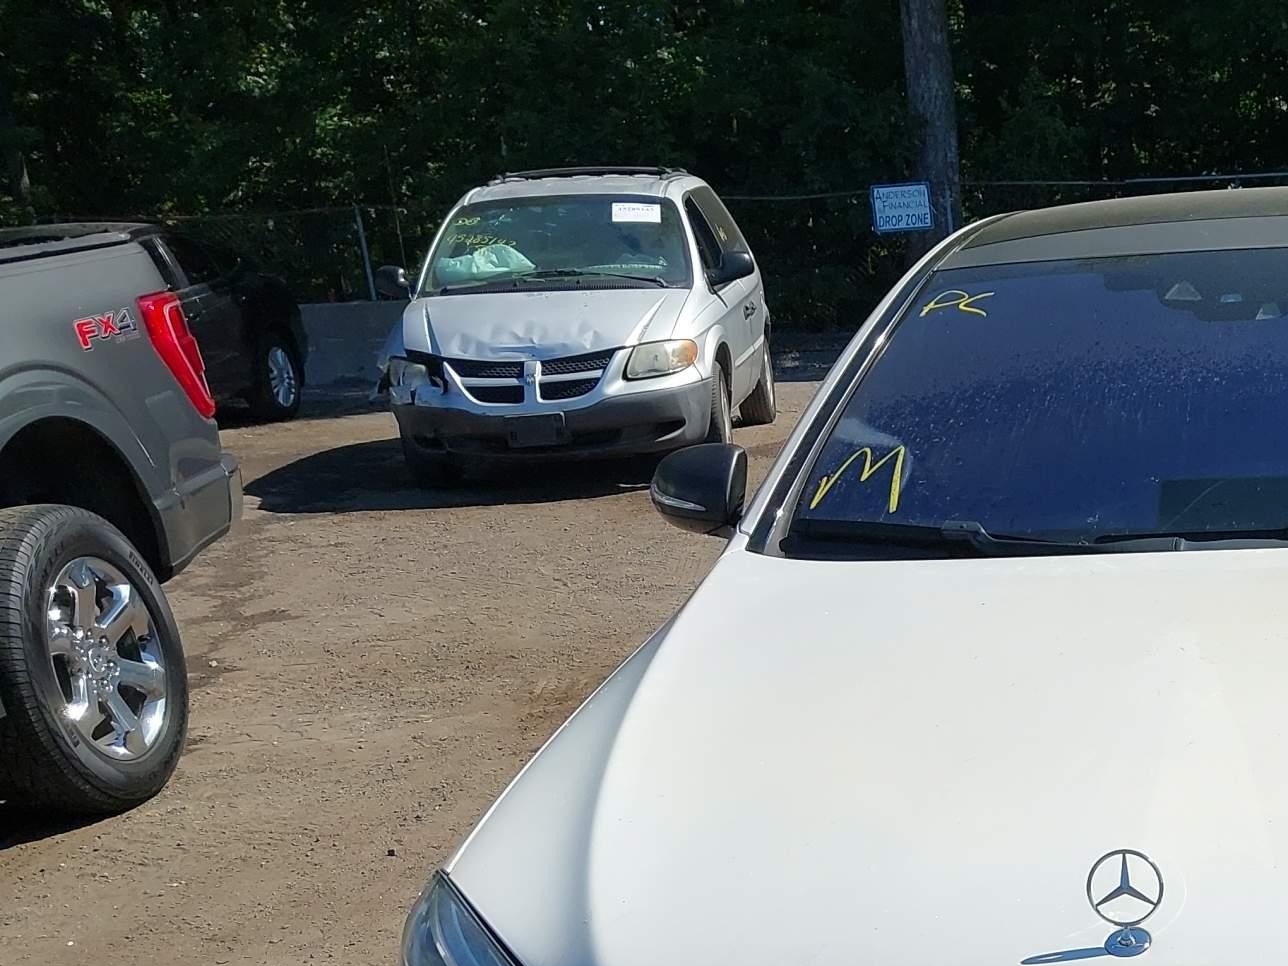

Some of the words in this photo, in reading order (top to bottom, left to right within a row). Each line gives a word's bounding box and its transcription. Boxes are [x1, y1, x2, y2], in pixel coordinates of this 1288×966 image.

[878, 214, 904, 228] DROP
[905, 212, 930, 226] ZONE
[73, 306, 137, 352] FX4
[809, 445, 906, 513] M
